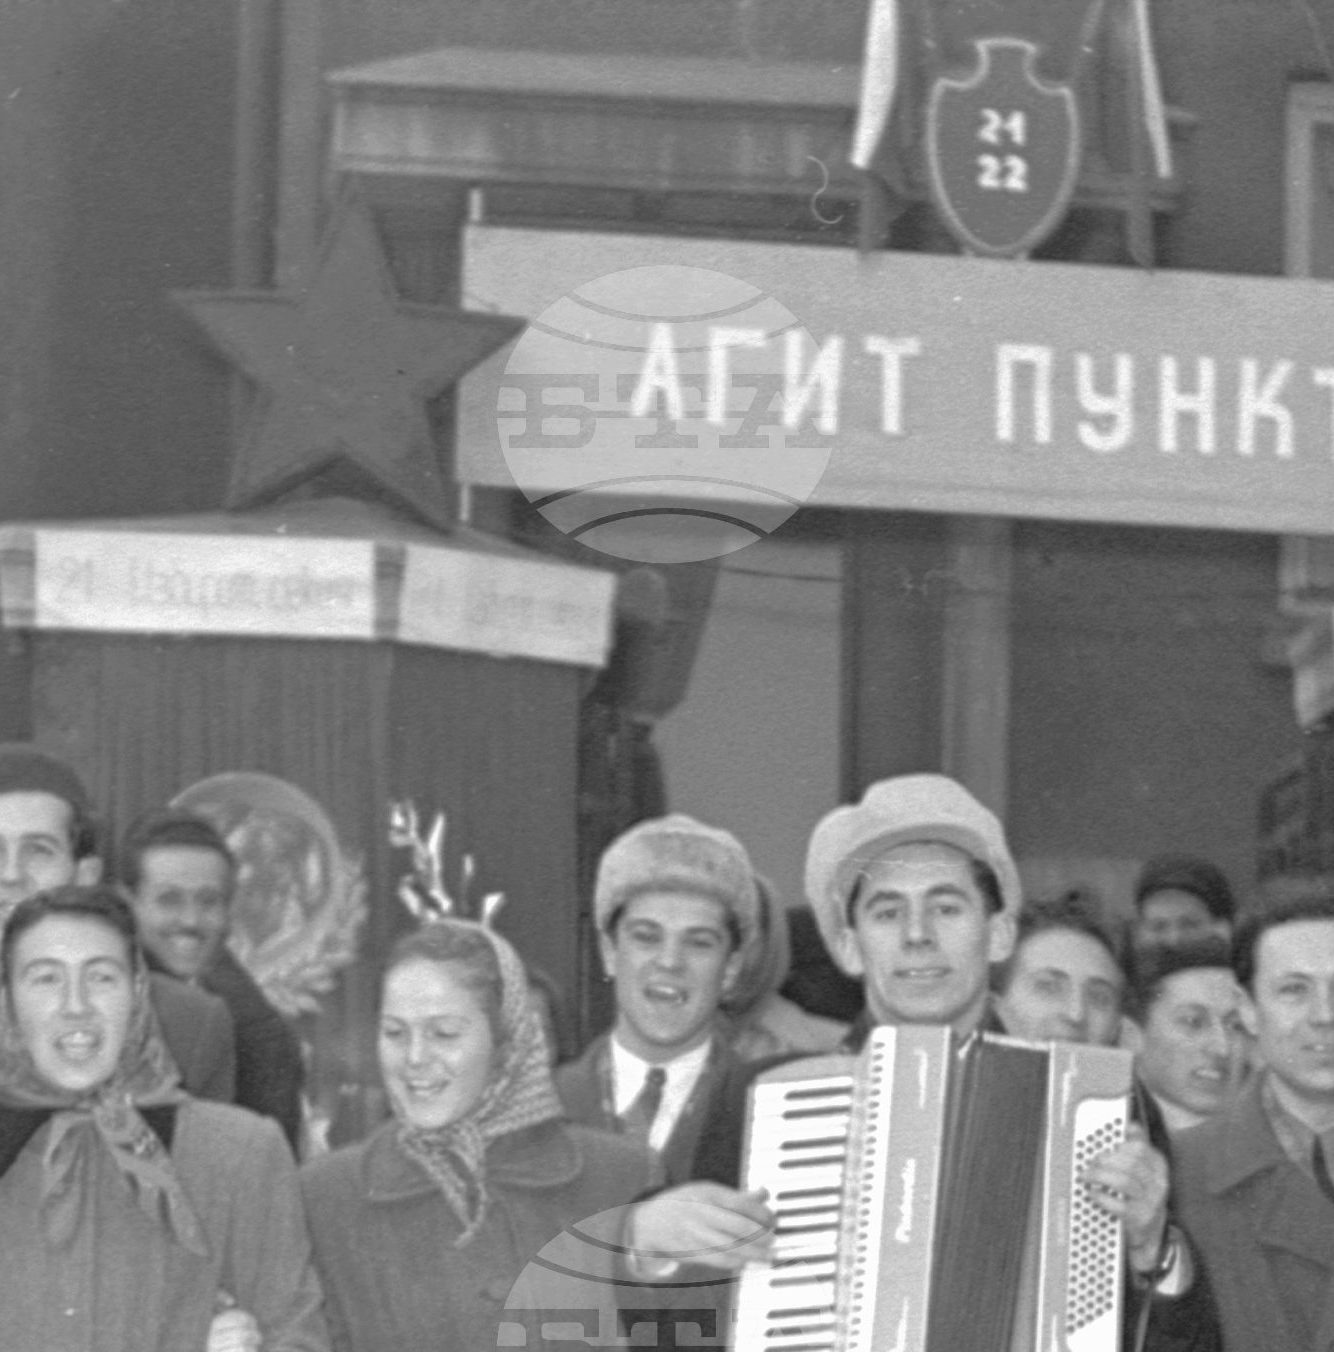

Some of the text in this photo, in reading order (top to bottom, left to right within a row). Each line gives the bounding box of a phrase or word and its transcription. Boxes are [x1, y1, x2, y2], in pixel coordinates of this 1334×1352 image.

[977, 107, 1028, 147] 21
[976, 153, 1029, 193] 22
[628, 322, 923, 436] АГИТ
